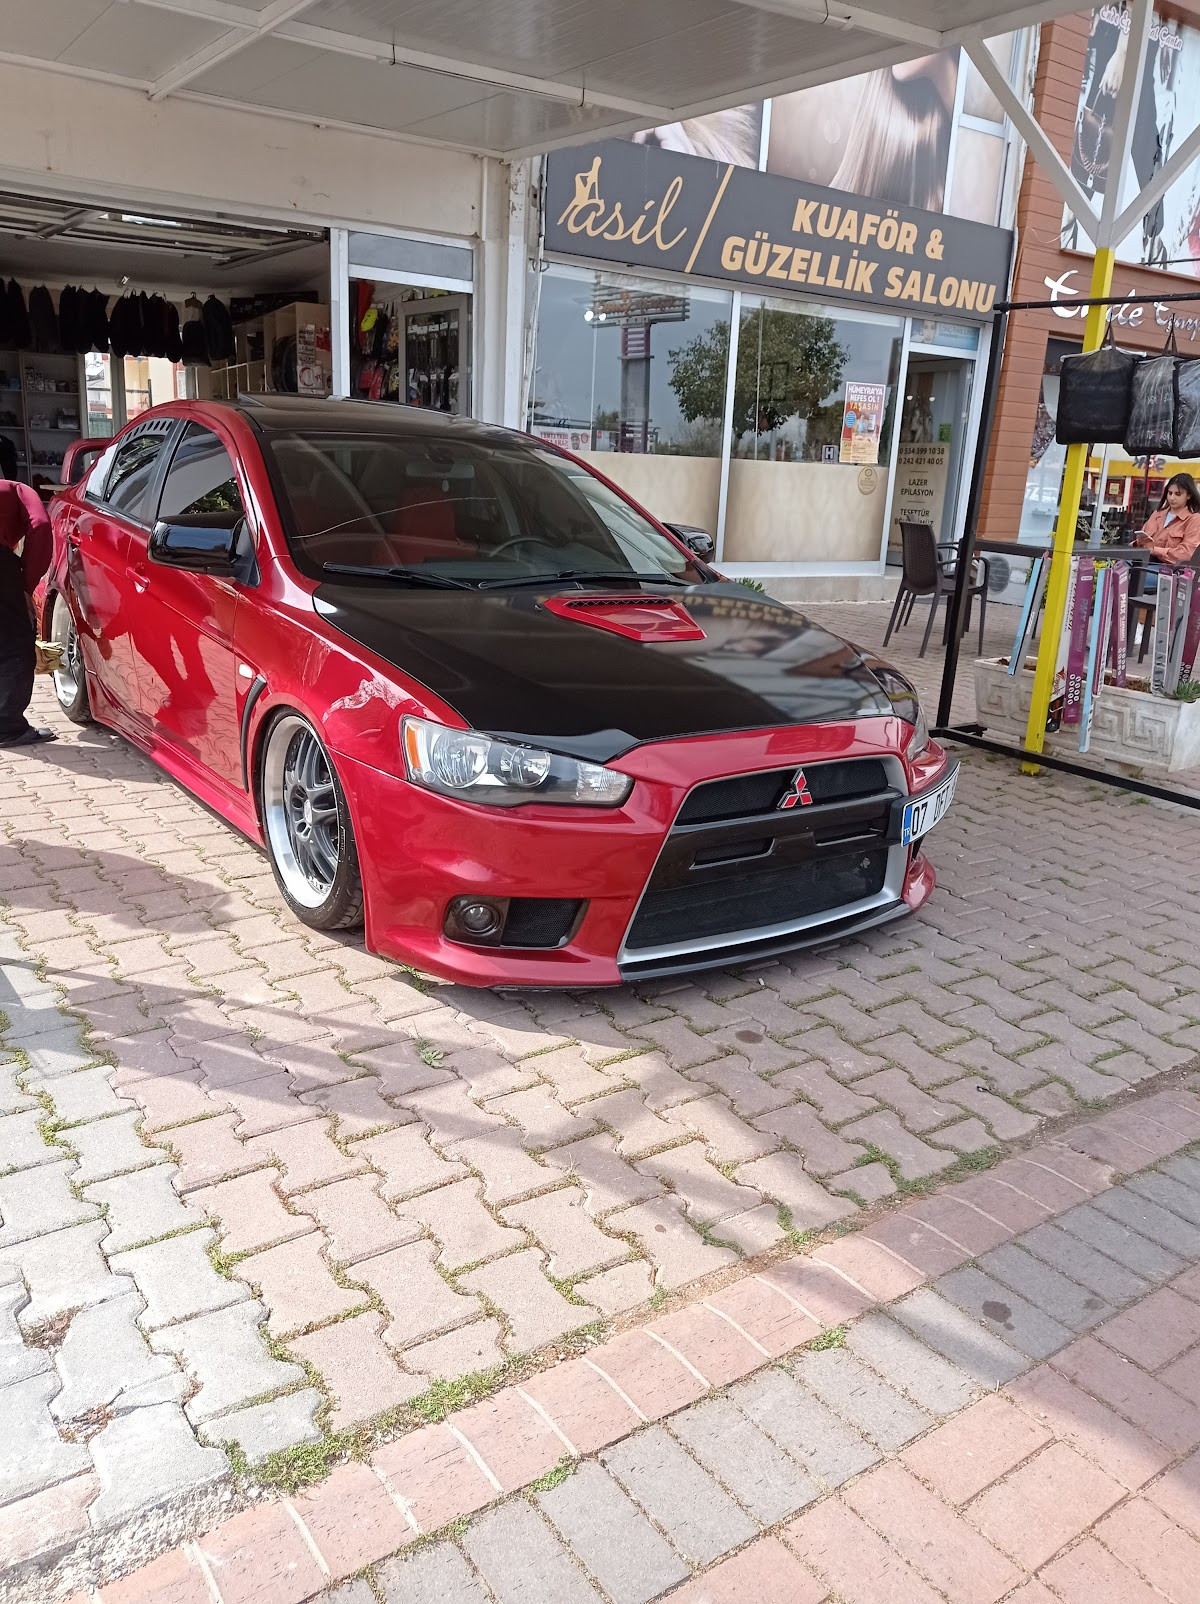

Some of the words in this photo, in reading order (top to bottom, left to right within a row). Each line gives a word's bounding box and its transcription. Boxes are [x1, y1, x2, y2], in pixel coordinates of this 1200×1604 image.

[792, 198, 918, 255] KUAFÖR
[925, 228, 945, 261] &
[721, 231, 879, 294] GÜZELLİK
[884, 266, 997, 313] SALONU
[848, 384, 883, 396] HÜMEYRA'YA
[850, 393, 867, 402] NEFES
[849, 402, 879, 412] YAŞASIN
[900, 488, 934, 497] EPİLASYON
[912, 801, 928, 836] 07
